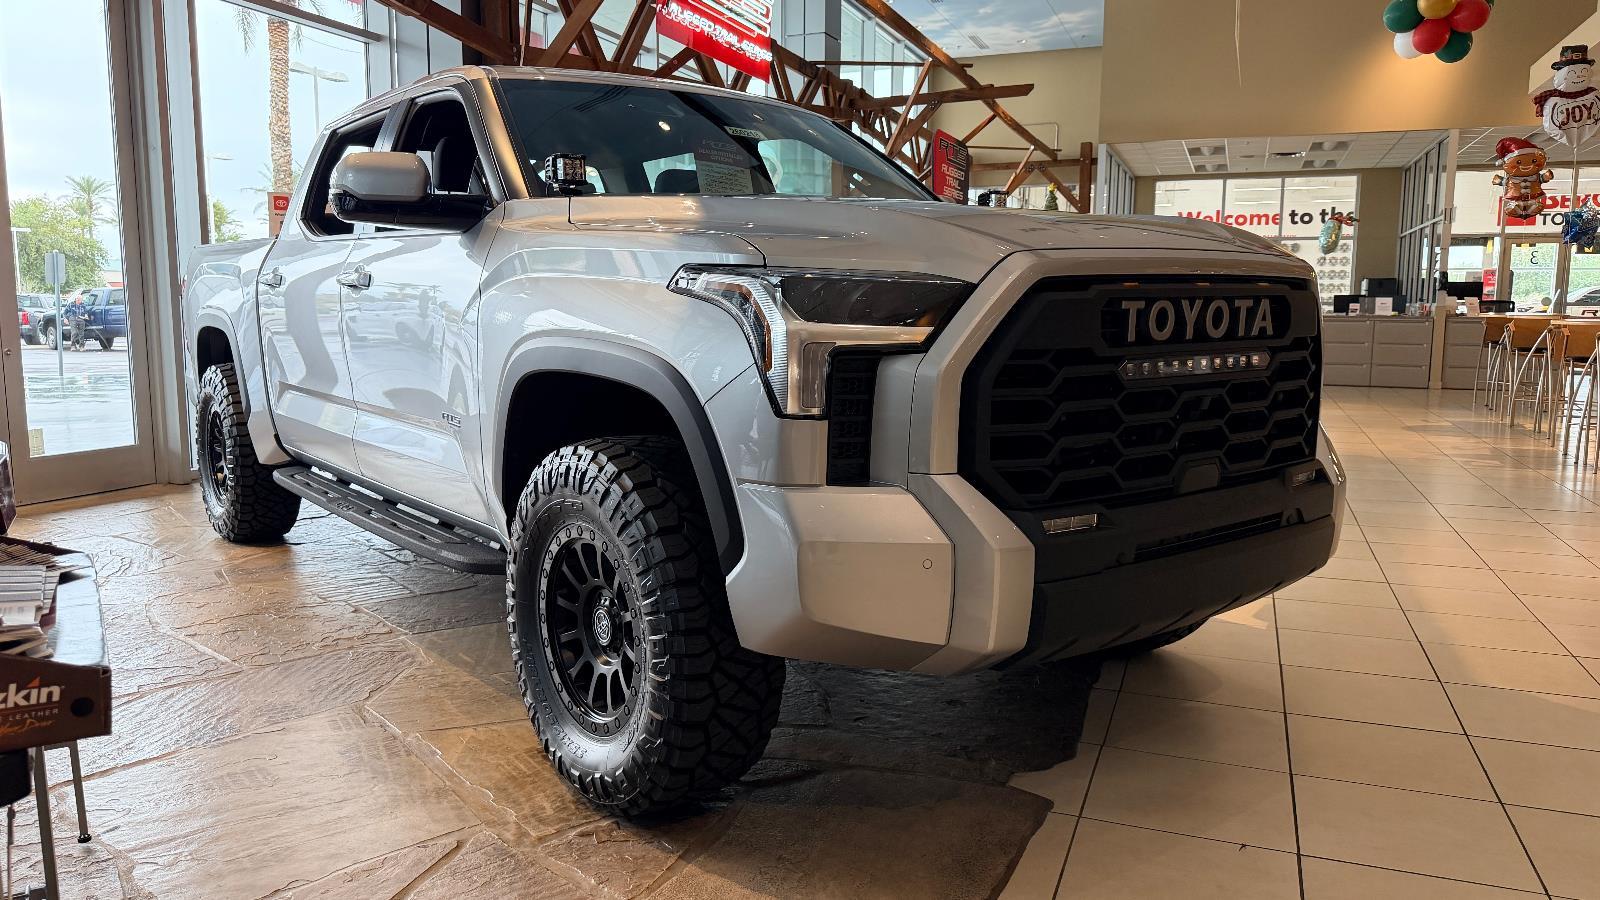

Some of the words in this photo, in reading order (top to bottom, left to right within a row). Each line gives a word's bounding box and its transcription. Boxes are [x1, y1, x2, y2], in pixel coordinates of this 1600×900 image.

[1560, 101, 1595, 127] JOY
[941, 163, 965, 180] RUGGED
[945, 175, 961, 189] TRAIL
[943, 185, 964, 200] SERIES
[1288, 209, 1314, 226] to
[1121, 298, 1274, 343] TOYOTA
[8, 708, 59, 721] LEATHER
